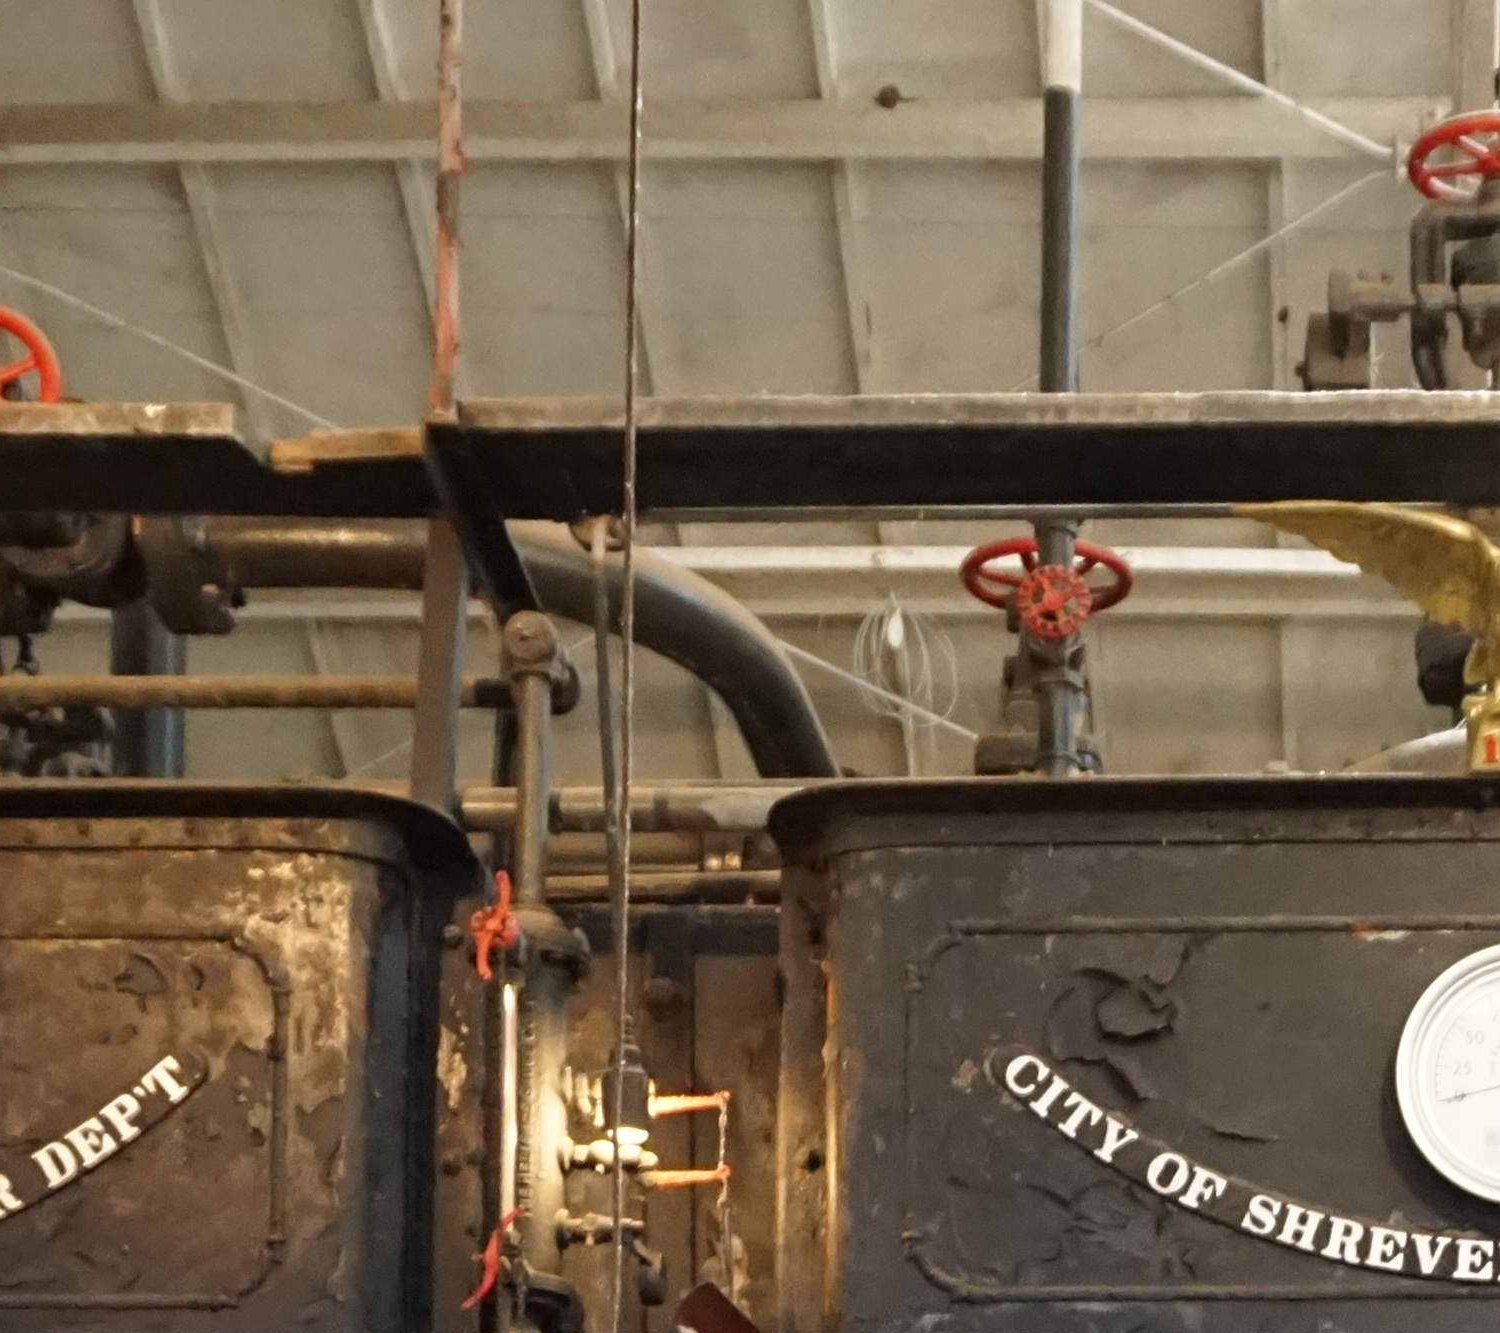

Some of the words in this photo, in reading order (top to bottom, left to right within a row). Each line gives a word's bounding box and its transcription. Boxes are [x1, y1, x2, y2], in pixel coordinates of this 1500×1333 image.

[1452, 1060, 1473, 1076] 25
[1465, 1030, 1486, 1045] 50
[30, 1055, 190, 1190] DEP'T
[1004, 1054, 1140, 1163] CITY
[1146, 1151, 1228, 1210] OF
